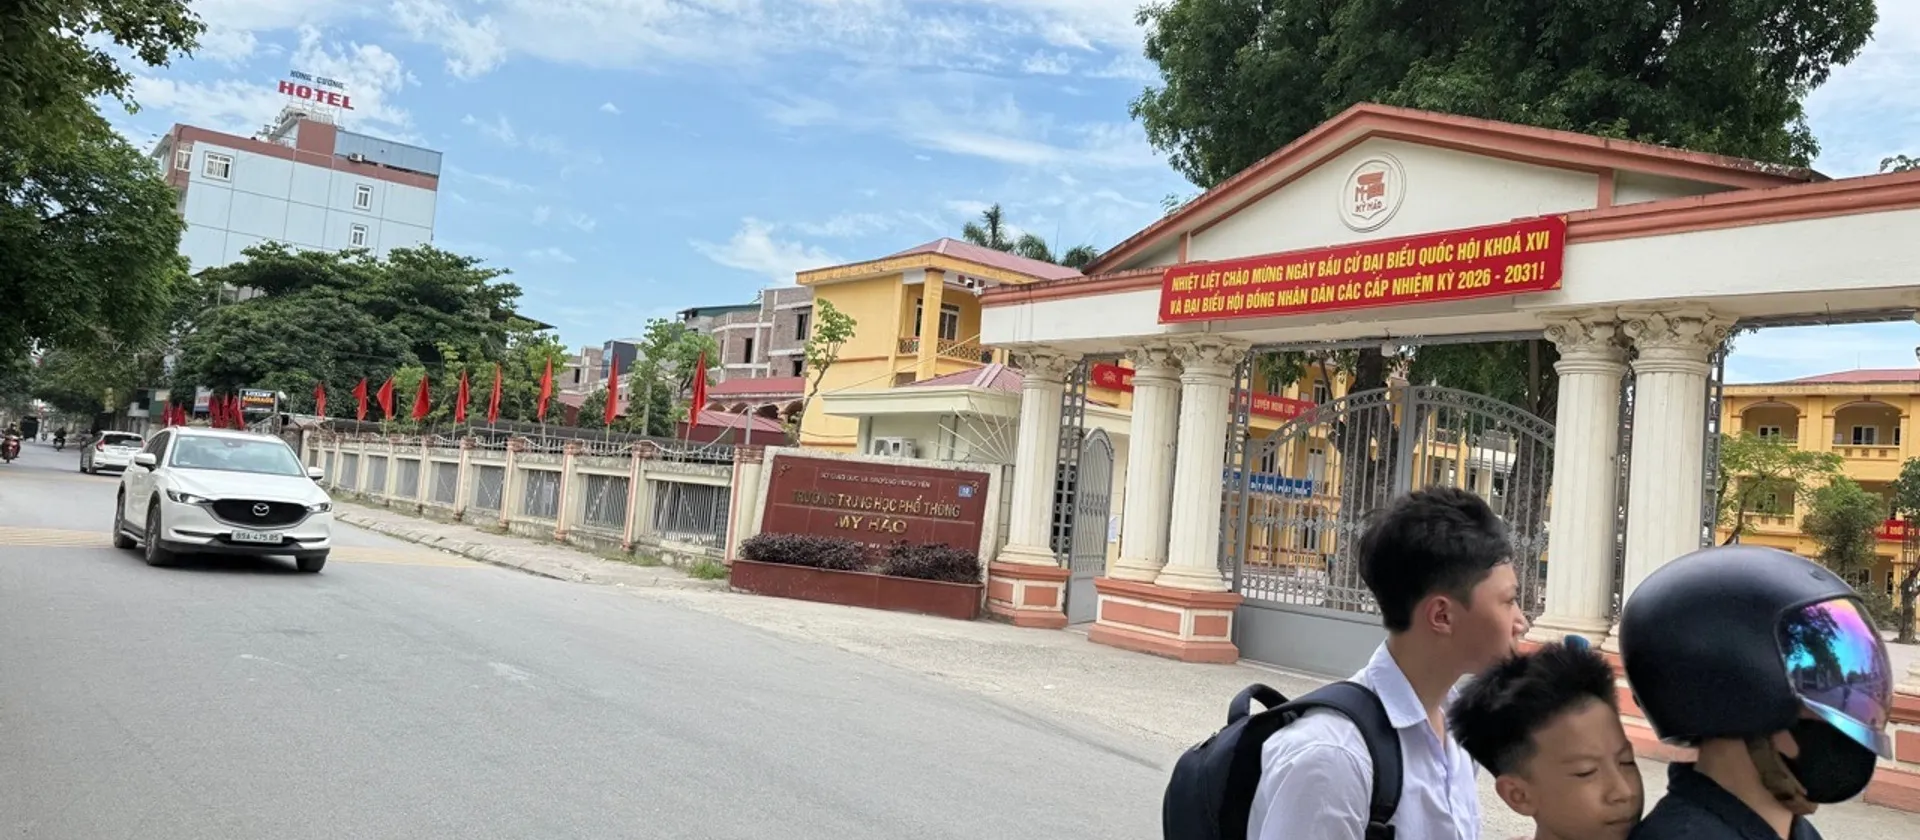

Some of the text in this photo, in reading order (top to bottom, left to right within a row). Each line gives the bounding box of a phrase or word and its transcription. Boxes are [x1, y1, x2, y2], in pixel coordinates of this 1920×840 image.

[278, 80, 355, 110] HOTEL
[1171, 230, 1550, 293] NHIỆT LIỆT CHÀO MỪNG NGÀY BẦU CỬ ĐẠI BIỂU QUỐC HỘI KHOÁ XVI
[1169, 296, 1182, 315] VÀ
[1183, 298, 1201, 317] ĐẠI
[1201, 290, 1226, 312] BIỂU
[1226, 291, 1245, 314] HỘI
[1246, 287, 1276, 309] ĐỒNG
[1277, 285, 1309, 307] NHÂN
[1310, 283, 1336, 304] DÂN
[1337, 280, 1362, 302] CÁC
[1364, 274, 1389, 299] CẤP
[1392, 272, 1435, 298] NHIỆM
[1437, 268, 1456, 292] KỲ
[1457, 267, 1492, 290] 2026
[1504, 260, 1546, 285] 2031!
[837, 493, 873, 510] TRUNG
[873, 496, 897, 513] HỌC
[899, 494, 921, 513] PHỔ
